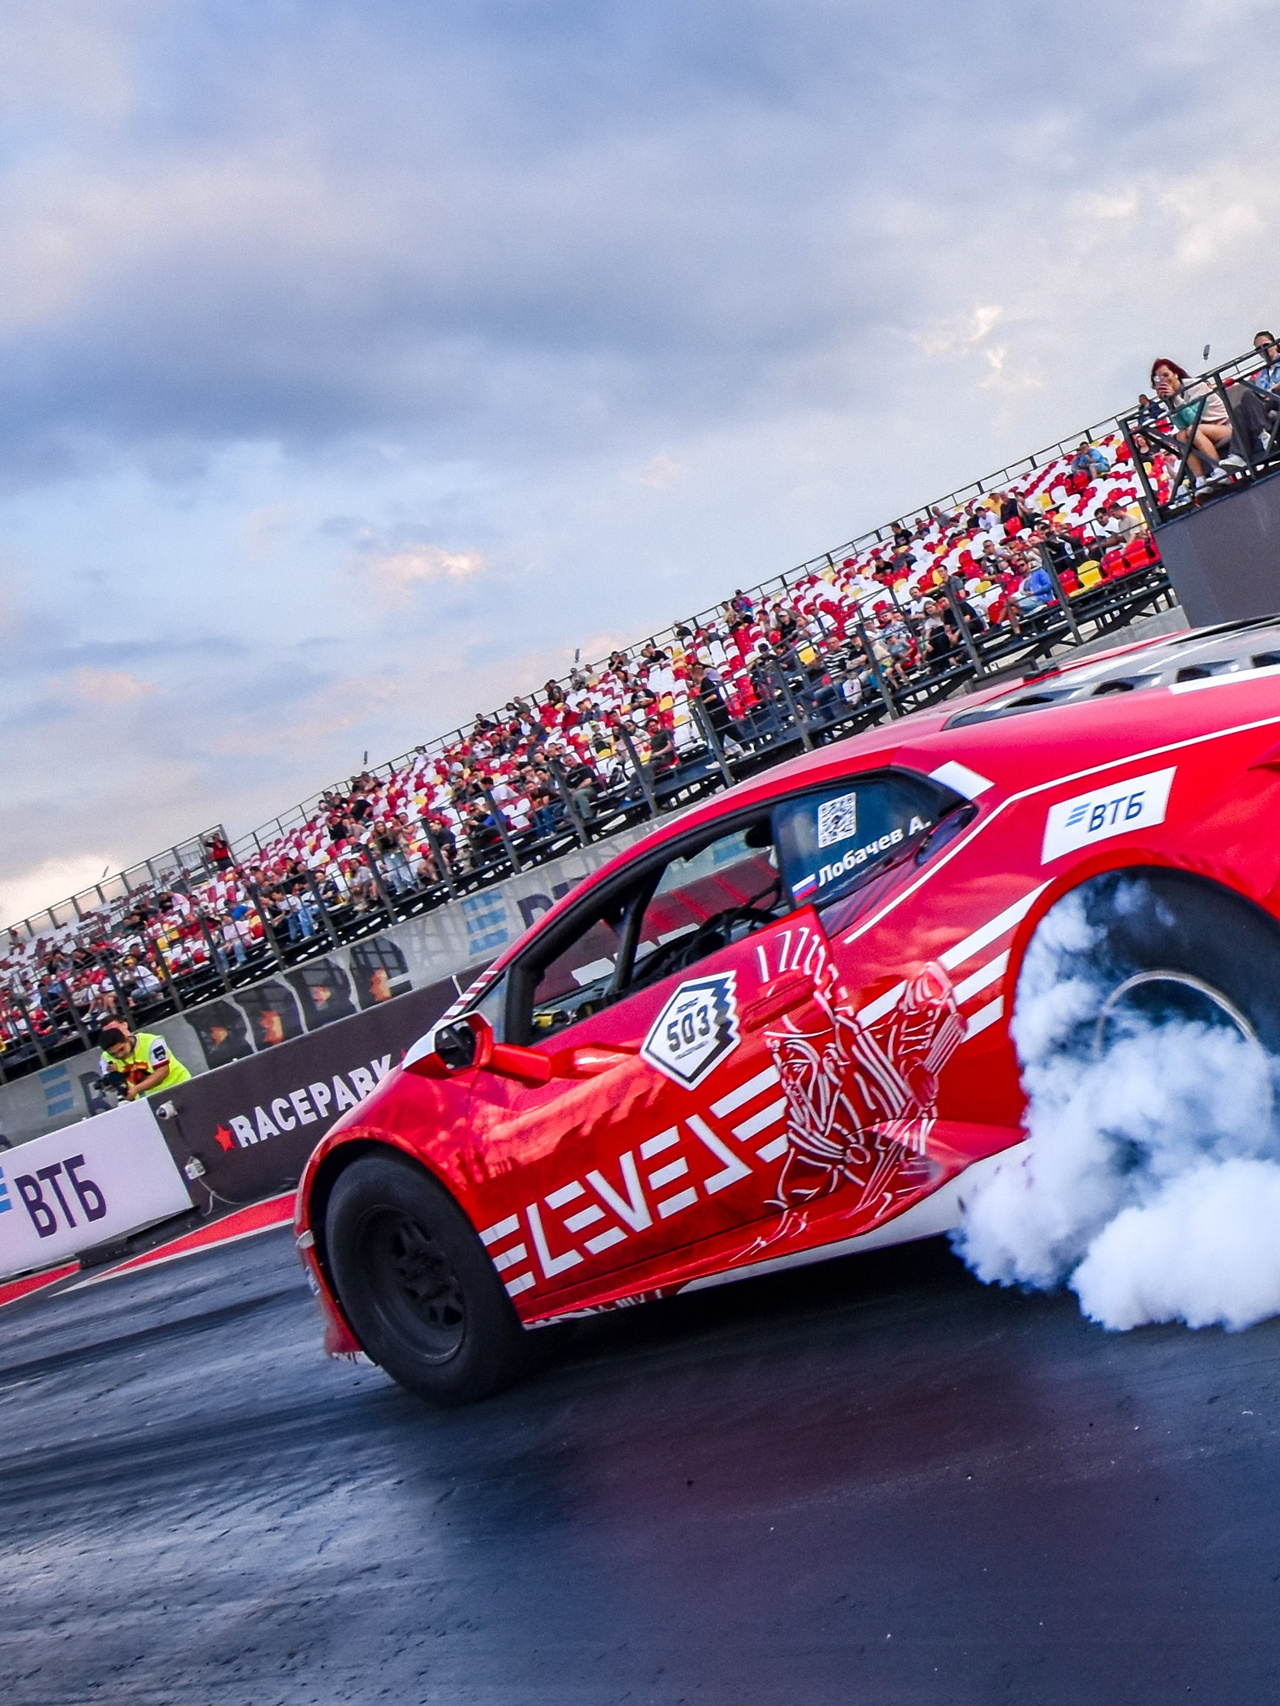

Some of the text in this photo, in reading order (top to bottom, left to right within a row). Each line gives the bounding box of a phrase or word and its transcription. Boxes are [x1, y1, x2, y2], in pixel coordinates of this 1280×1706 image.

[1087, 790, 1147, 833] ВТБ
[818, 816, 932, 888] Лобачев А.
[667, 1004, 711, 1053] 503
[14, 1154, 107, 1239] ВТБ
